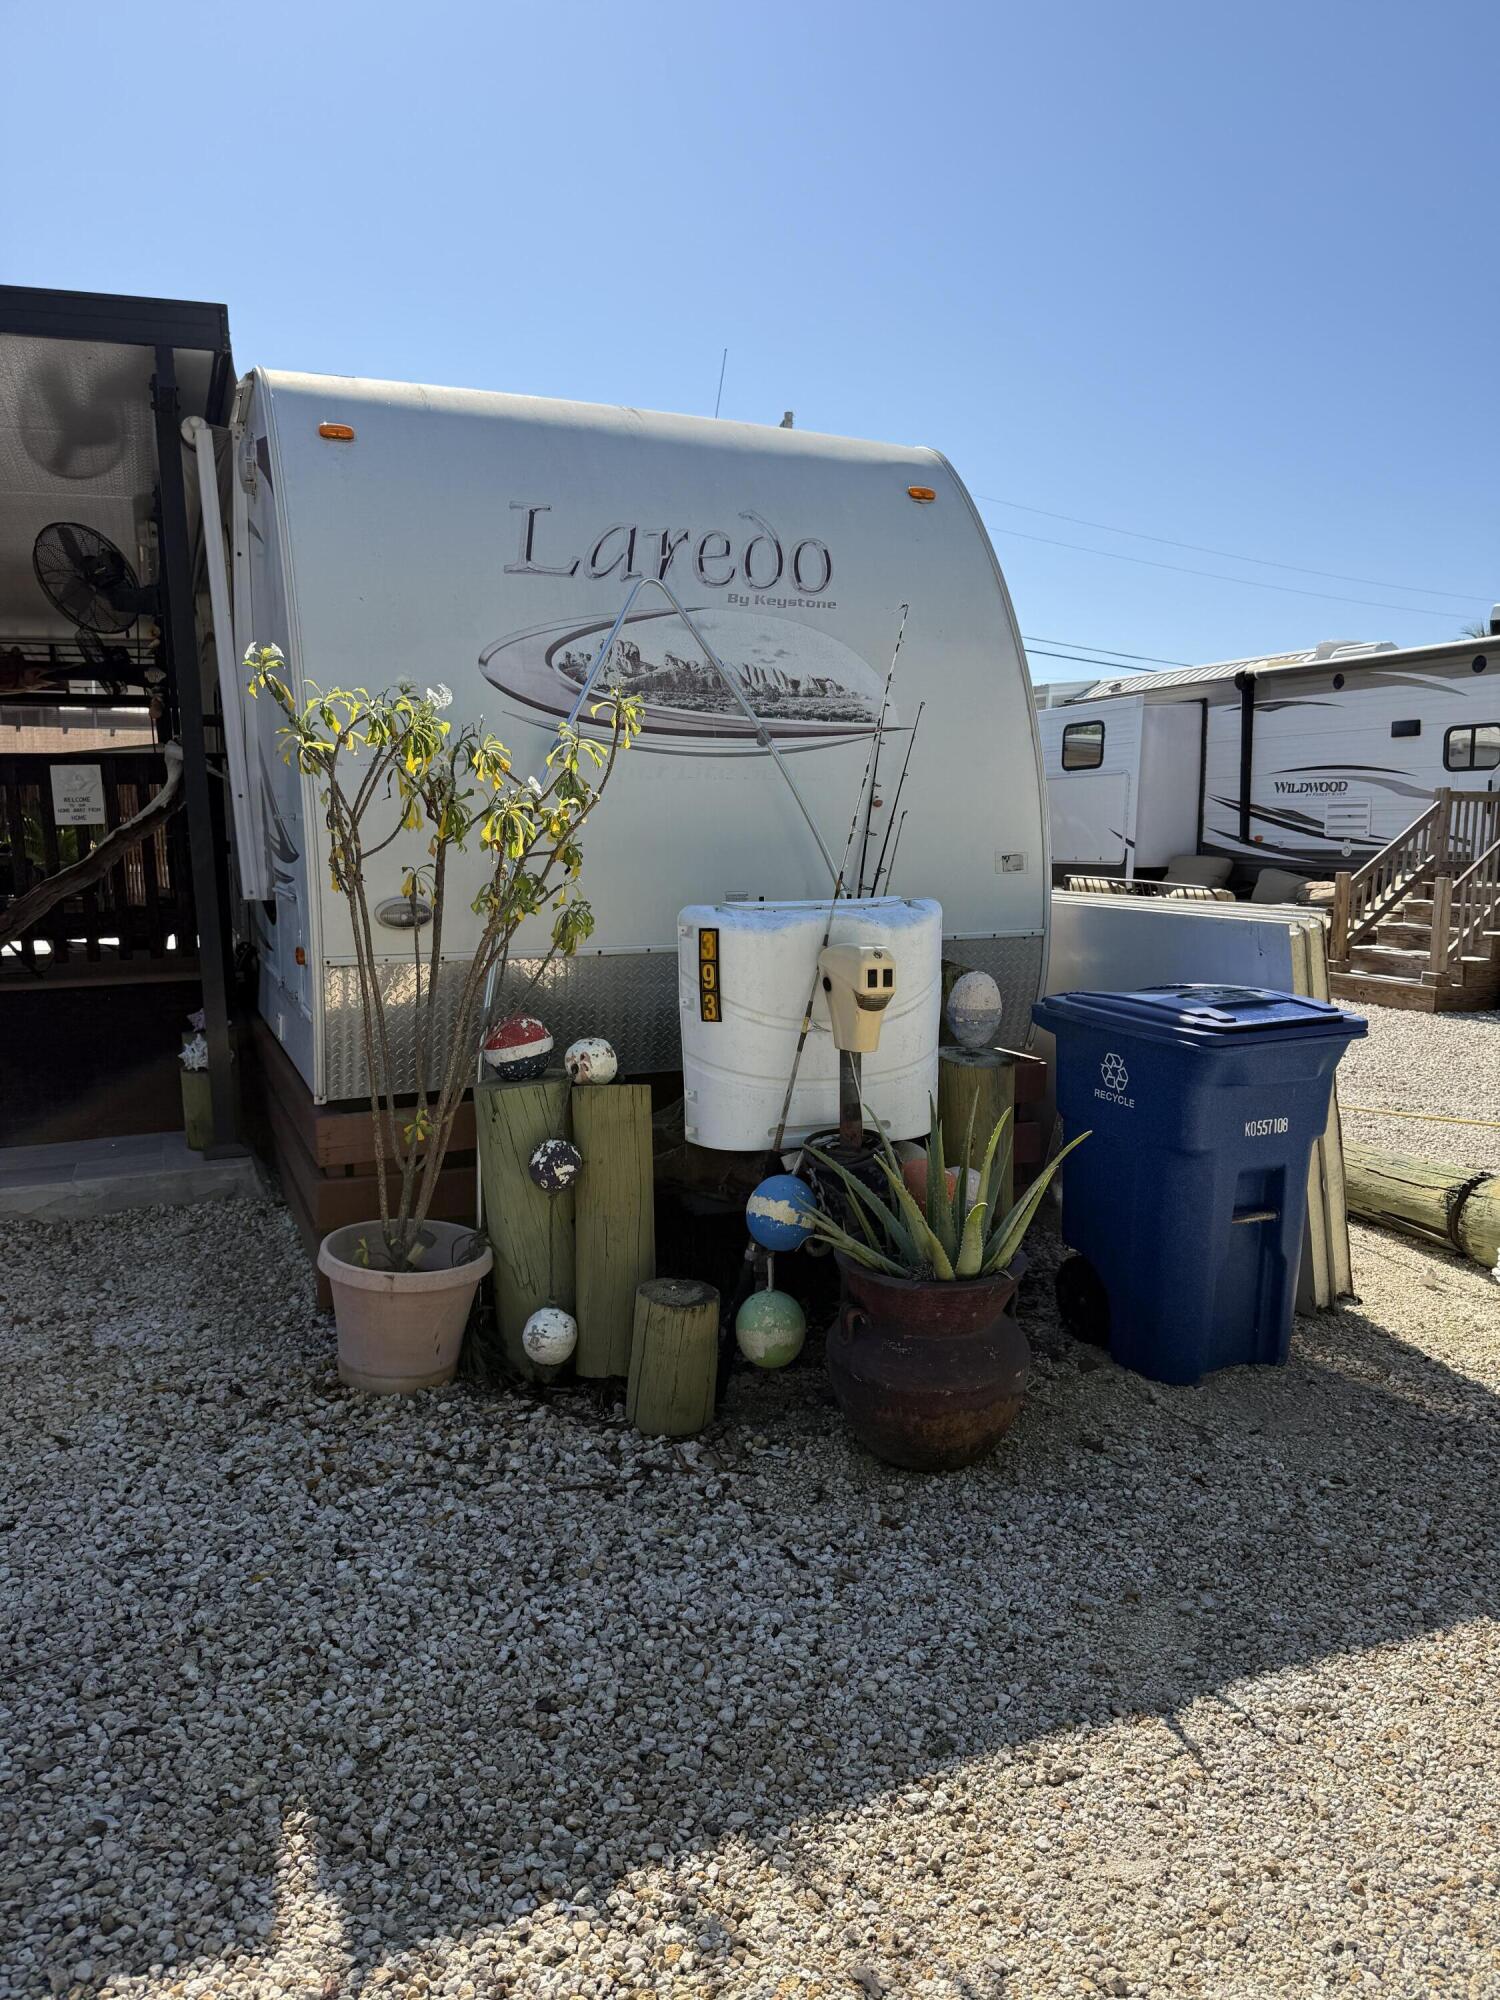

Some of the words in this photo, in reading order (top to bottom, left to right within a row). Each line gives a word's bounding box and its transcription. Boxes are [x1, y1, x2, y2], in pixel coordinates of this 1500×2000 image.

[504, 501, 834, 595] Laredo
[728, 593, 750, 607] By
[755, 595, 837, 609] Keystone
[1274, 781, 1348, 794] WILDWOOD
[702, 932, 717, 1021] 393
[1094, 1088, 1136, 1109] RECYCLE
